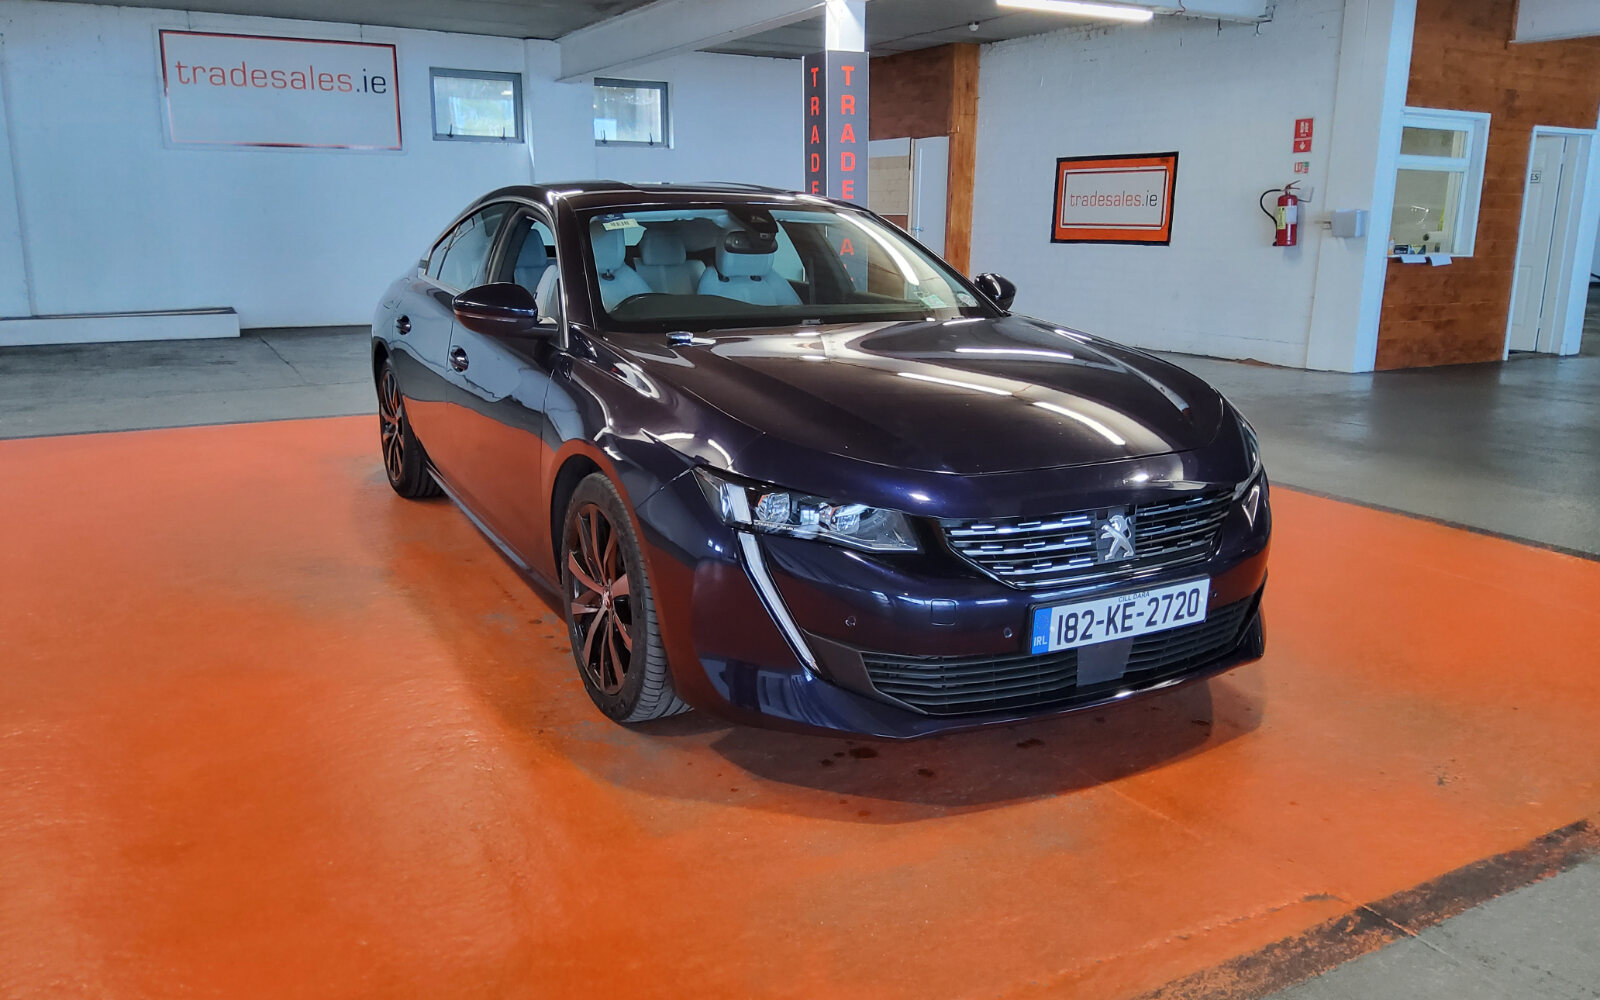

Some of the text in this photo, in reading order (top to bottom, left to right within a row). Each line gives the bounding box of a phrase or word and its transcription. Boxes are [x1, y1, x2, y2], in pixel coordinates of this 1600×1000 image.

[175, 60, 387, 94] tradesales.ie
[841, 66, 856, 199] TRADE
[1070, 190, 1158, 207] tradesales.ie
[1056, 588, 1199, 645] 182-KE-2720
[1034, 635, 1048, 646] IRL
